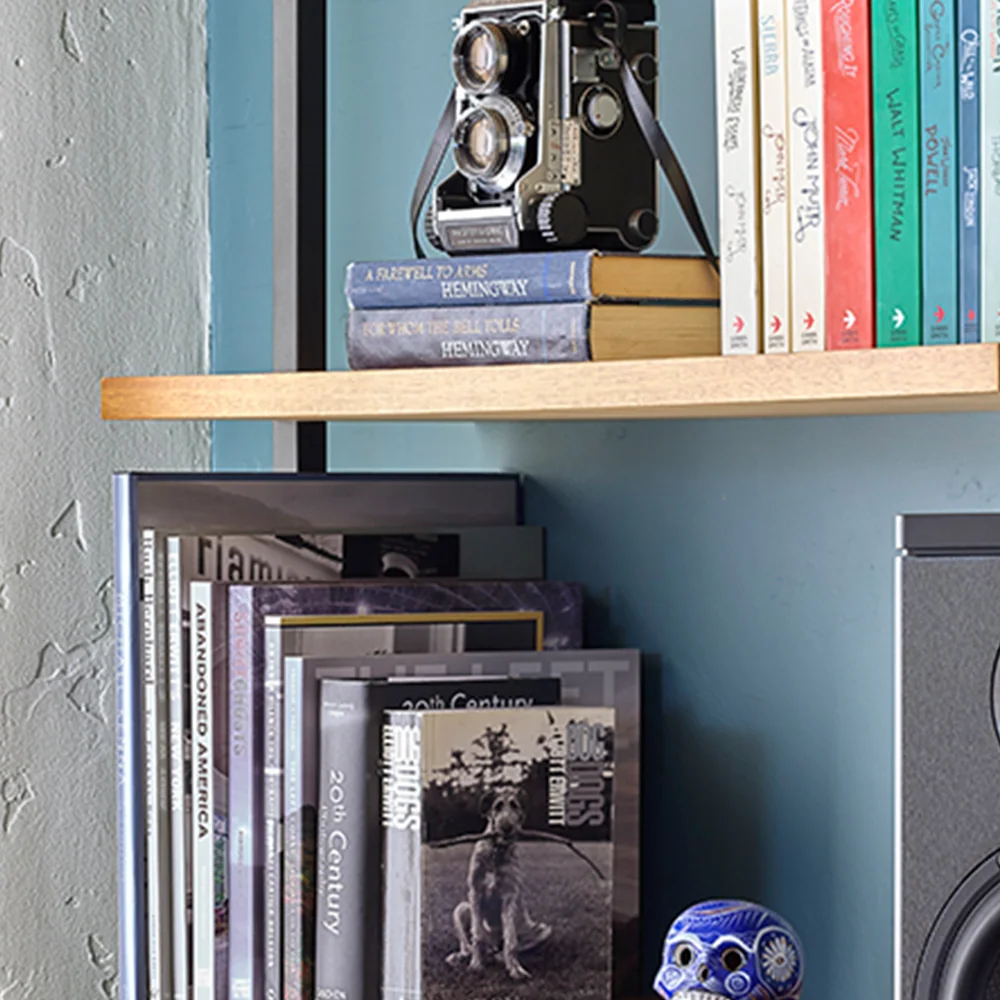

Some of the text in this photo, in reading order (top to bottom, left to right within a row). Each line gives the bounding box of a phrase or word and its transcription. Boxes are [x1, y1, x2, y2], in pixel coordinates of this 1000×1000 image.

[761, 14, 780, 76] SIERRA
[792, 107, 821, 243] JOHN MUIR
[886, 87, 907, 242] WALT WHITMAN
[924, 123, 939, 197] POWELL
[364, 264, 488, 282] A FAREWELL TO ARMS
[441, 279, 529, 299] HEMINGWAY
[441, 340, 530, 359] HEMINGWAY
[453, 320, 481, 335] BELL
[196, 602, 209, 838] ABANDONED AMERICA
[394, 763, 421, 830] DOGS
[566, 761, 605, 827] DOGS
[323, 770, 348, 936] 20th Century
